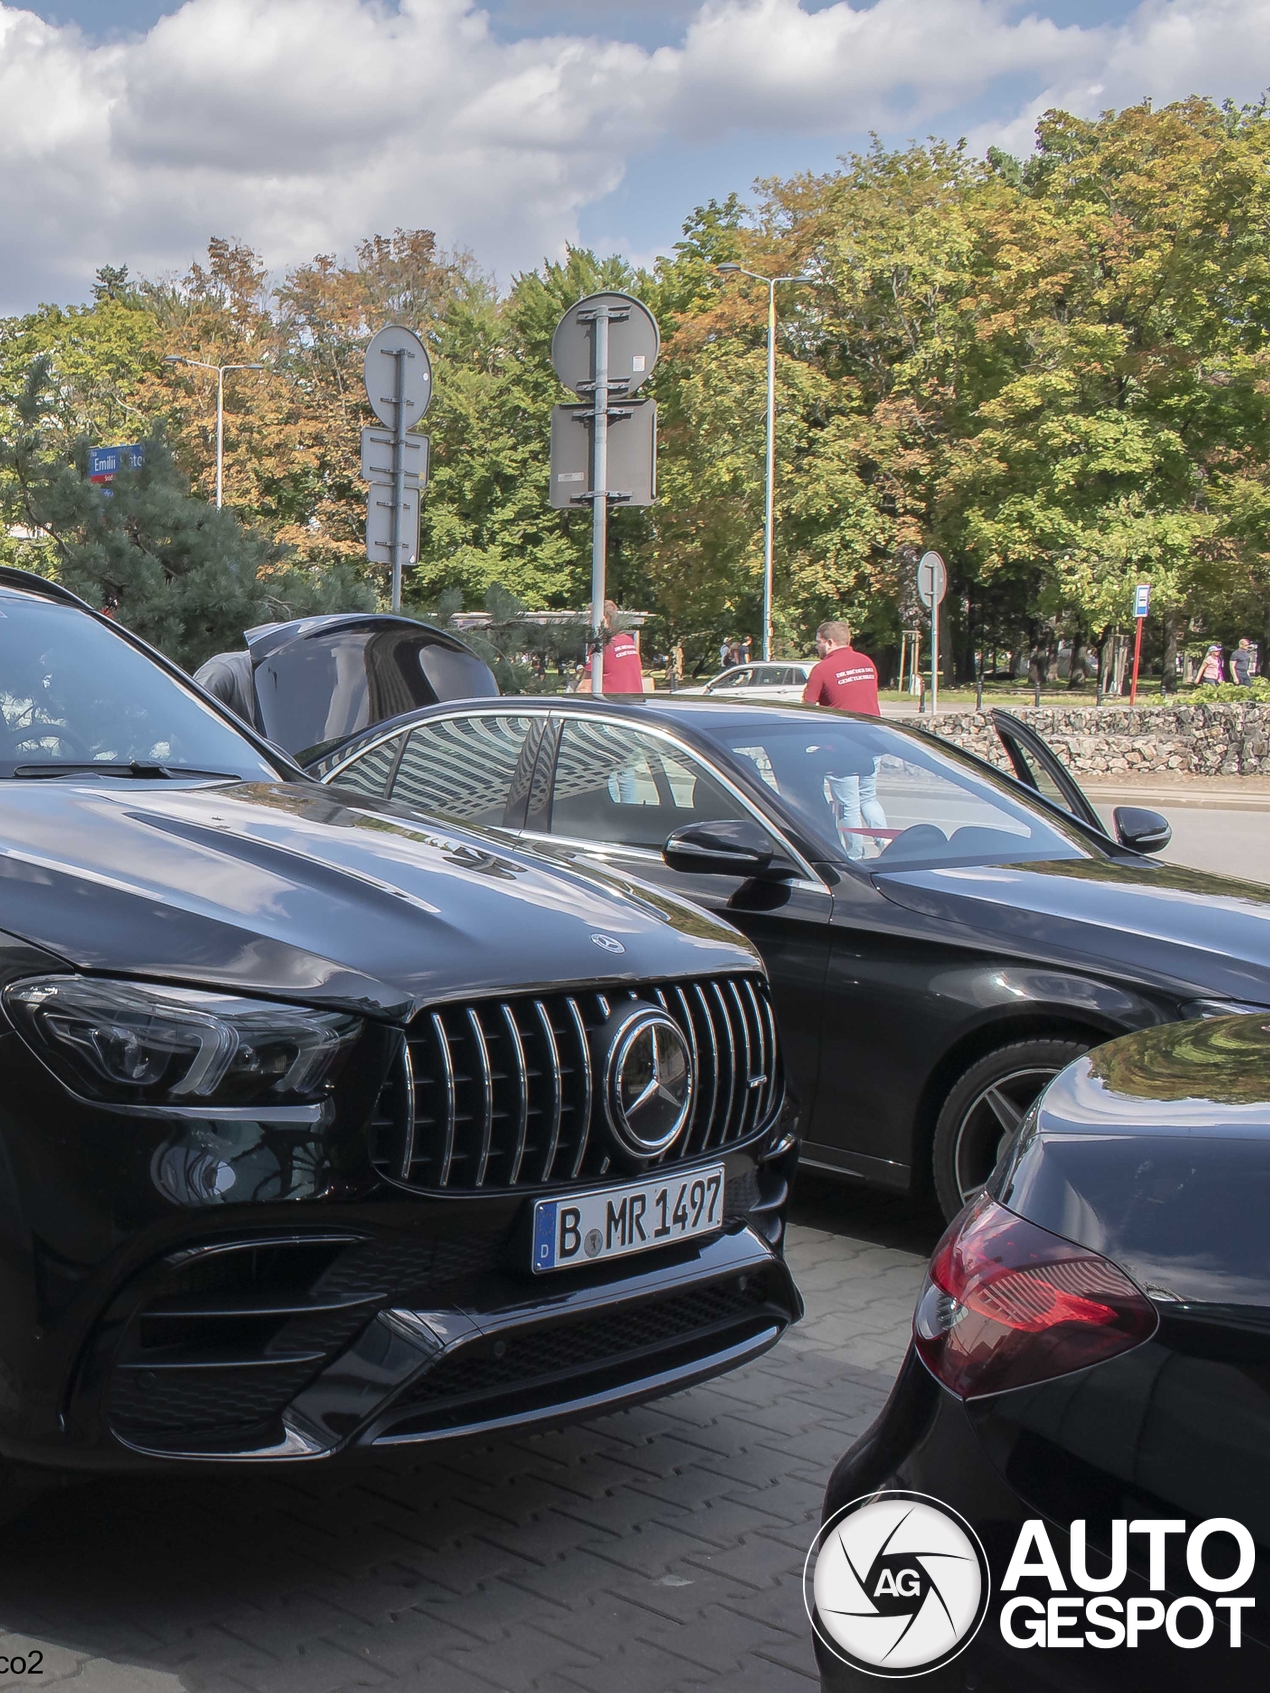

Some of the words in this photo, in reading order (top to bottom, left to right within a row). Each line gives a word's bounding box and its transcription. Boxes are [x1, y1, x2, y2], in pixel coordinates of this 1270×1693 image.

[94, 455, 116, 471] Emilii
[559, 1206, 582, 1259] B
[605, 1193, 647, 1250] MR
[653, 1174, 722, 1239] 1497
[540, 1244, 549, 1259] D
